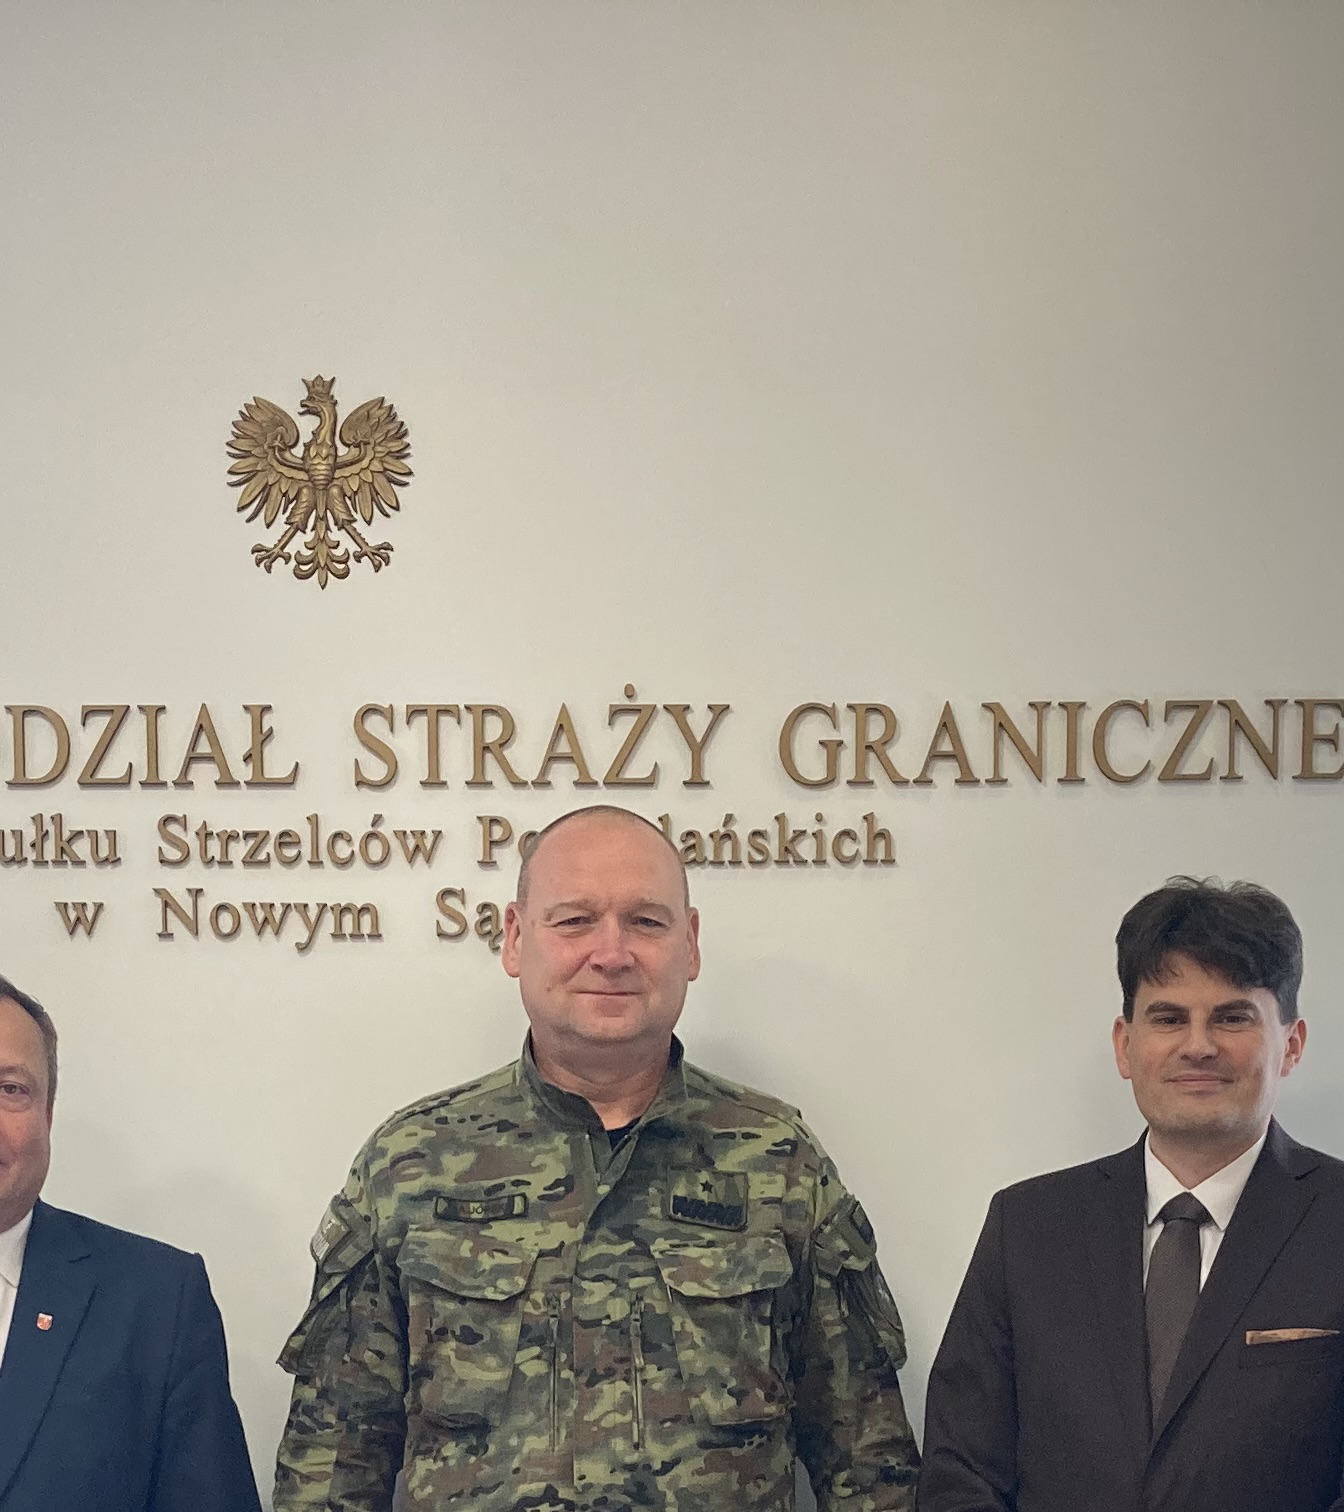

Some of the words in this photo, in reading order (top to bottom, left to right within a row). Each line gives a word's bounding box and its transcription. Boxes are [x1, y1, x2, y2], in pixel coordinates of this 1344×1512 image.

[353, 683, 733, 792] STRAŻY
[158, 812, 444, 870] Strzelców
[54, 901, 104, 941] w
[152, 887, 383, 956] Nowym
